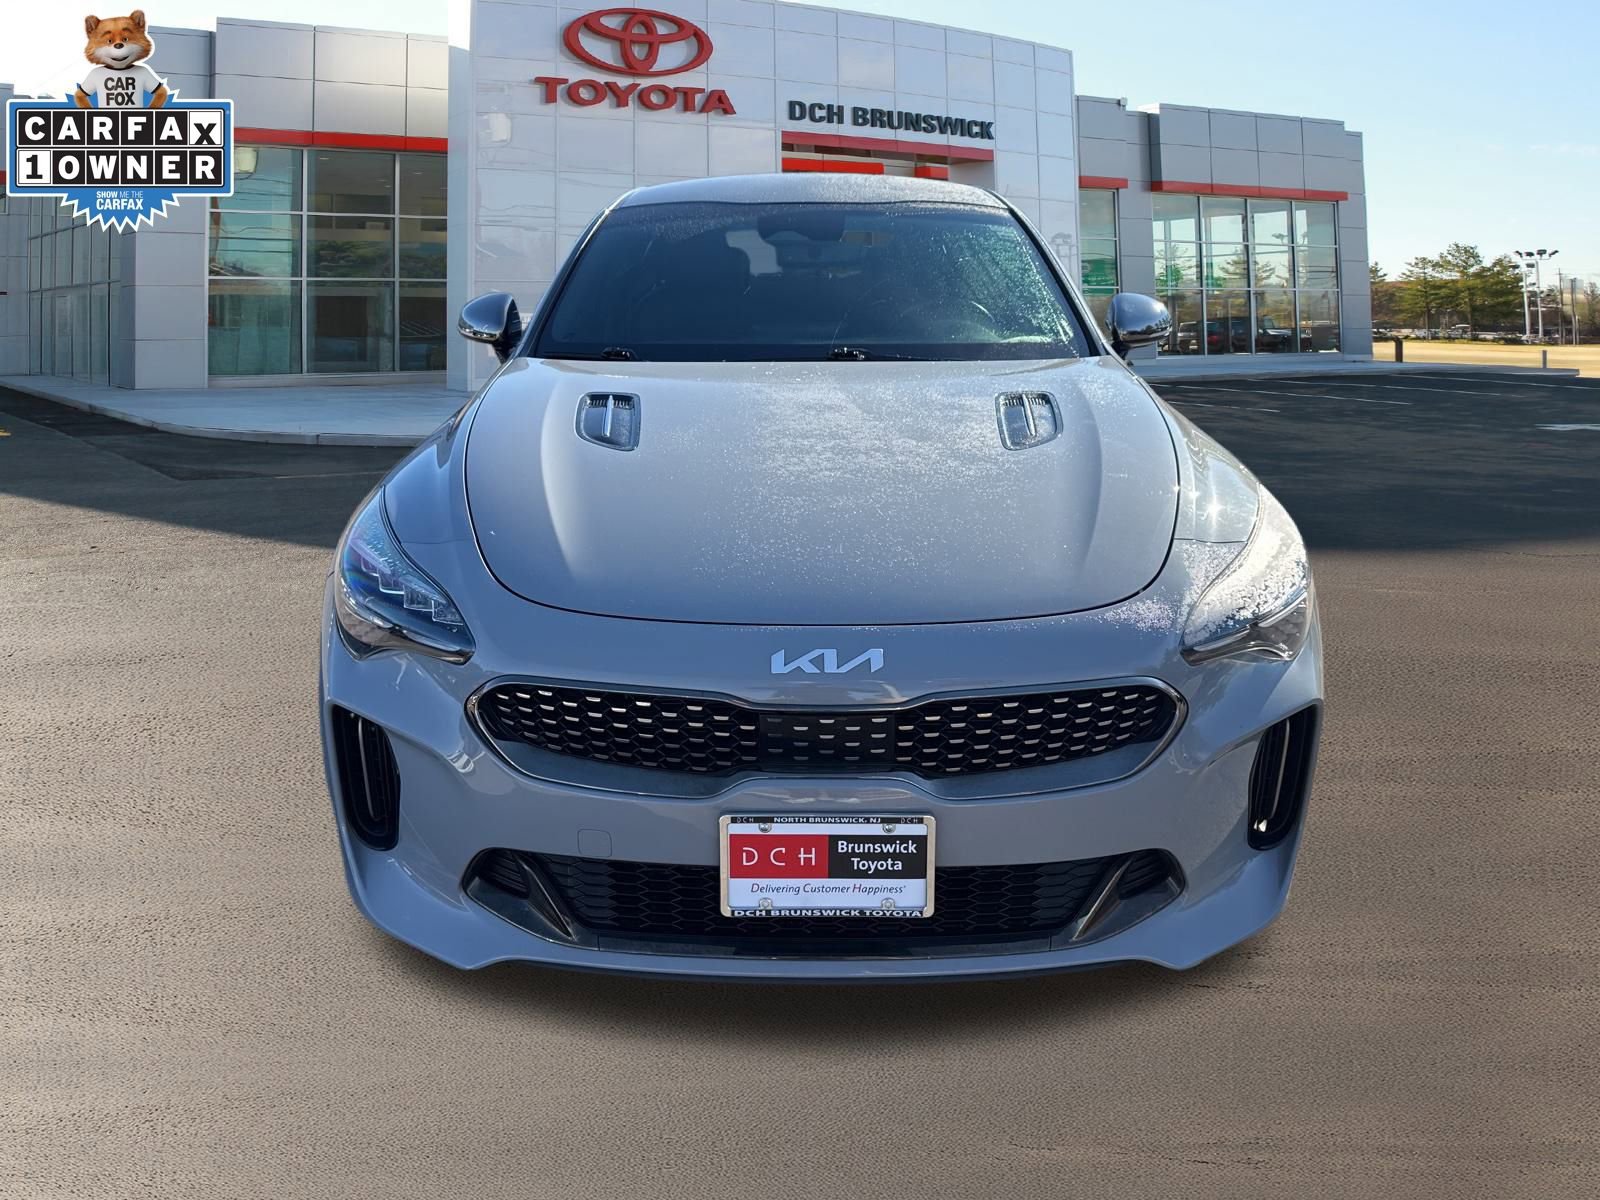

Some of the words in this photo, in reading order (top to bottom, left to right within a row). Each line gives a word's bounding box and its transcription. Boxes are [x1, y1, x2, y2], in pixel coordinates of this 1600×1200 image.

[535, 76, 737, 115] TOYOTA
[788, 100, 845, 124] DCH
[852, 106, 994, 140] BRUNSWICK
[837, 840, 917, 854] Brunswick
[851, 857, 903, 874] Toyota
[750, 883, 801, 896] Delivering
[803, 883, 850, 894] Customer
[770, 909, 862, 917] BRUNSWICK
